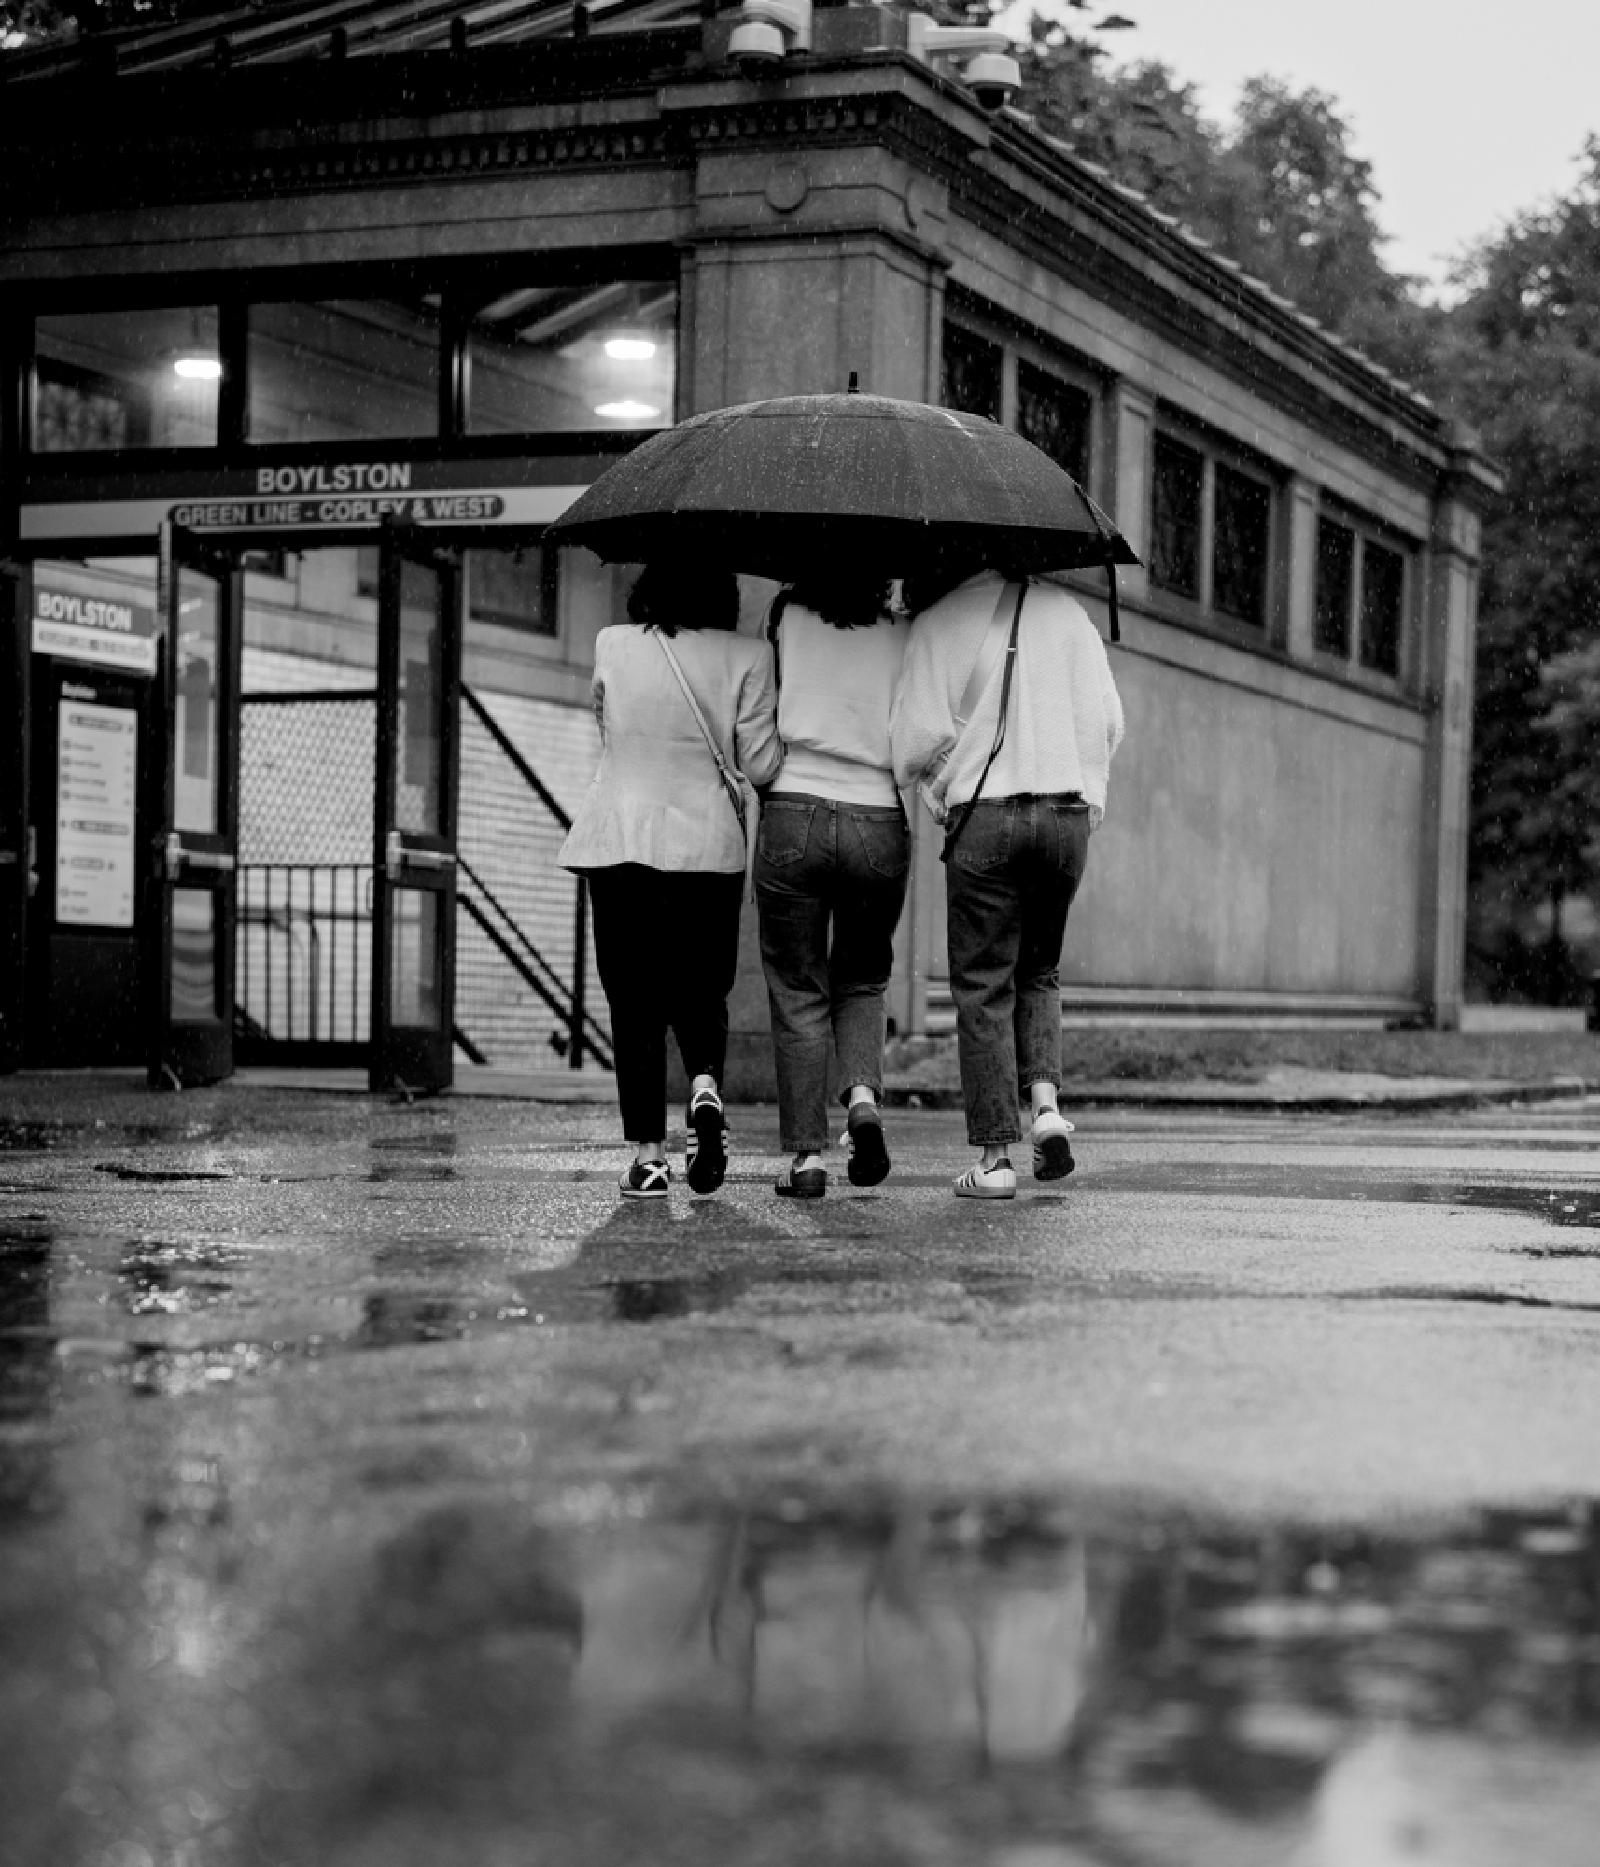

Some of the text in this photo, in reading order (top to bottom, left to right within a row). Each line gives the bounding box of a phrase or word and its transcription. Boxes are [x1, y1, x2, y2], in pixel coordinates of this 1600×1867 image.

[257, 462, 411, 493] BOYLSTON
[176, 503, 247, 526] GREEN
[254, 502, 301, 524] LINE
[413, 497, 425, 518] &
[432, 496, 492, 518] WEST
[38, 592, 132, 632] BOYLSTON
